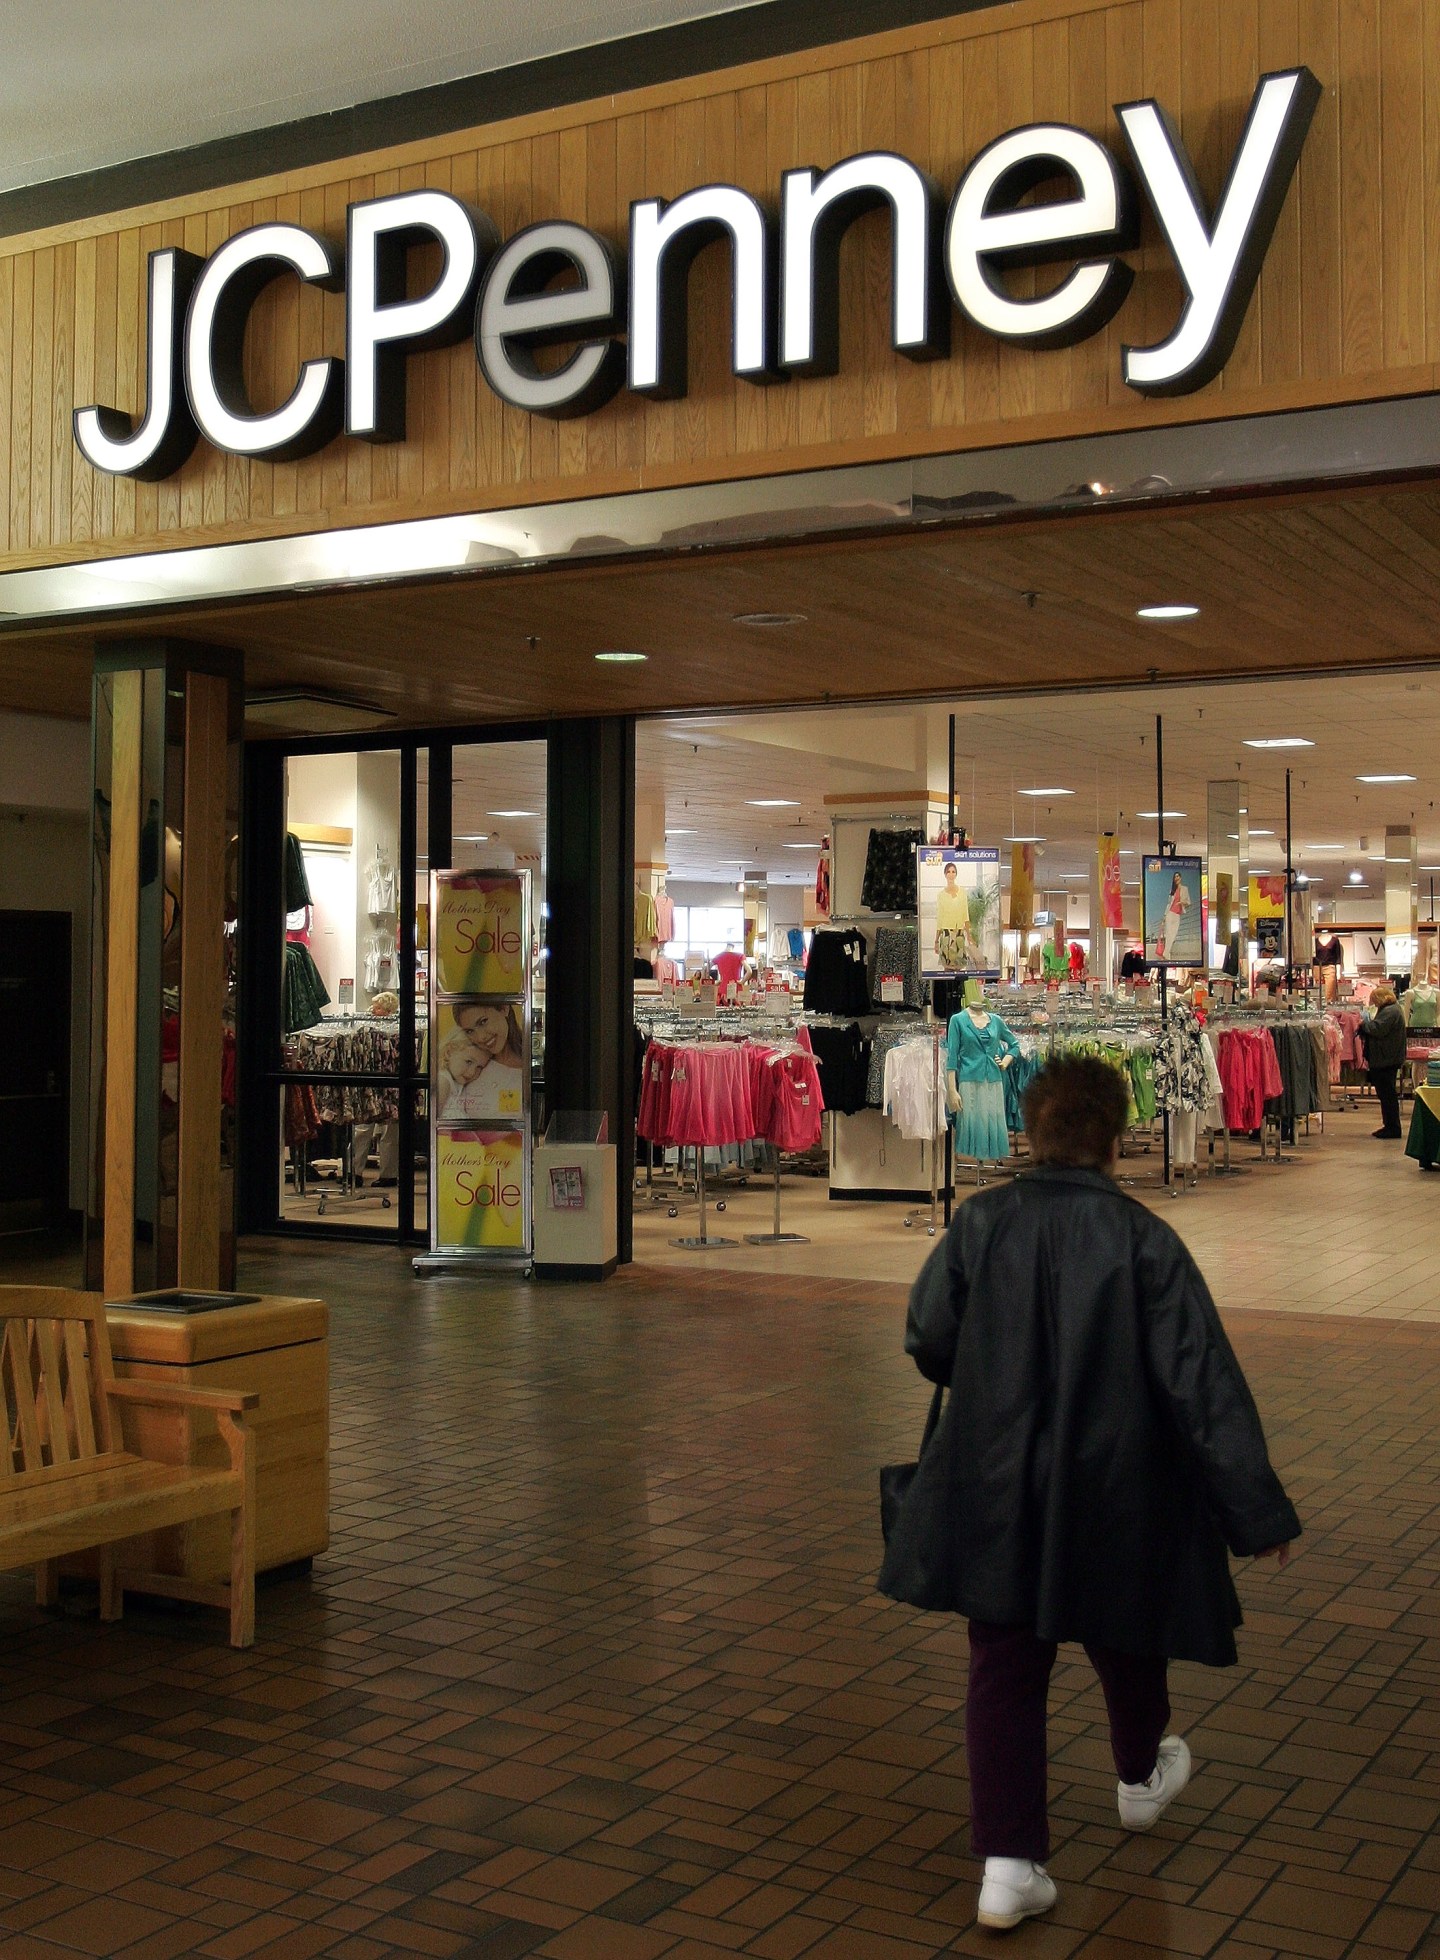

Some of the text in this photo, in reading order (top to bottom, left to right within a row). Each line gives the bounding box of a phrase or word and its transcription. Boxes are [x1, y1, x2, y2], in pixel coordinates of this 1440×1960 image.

[72, 65, 1323, 482] JCPenney
[954, 850, 997, 859] skirt solutions
[1258, 918, 1280, 929] Disney
[454, 915, 521, 954] Sale
[885, 975, 899, 983] sale
[770, 984, 786, 992] sale
[454, 1167, 521, 1207] Sale
